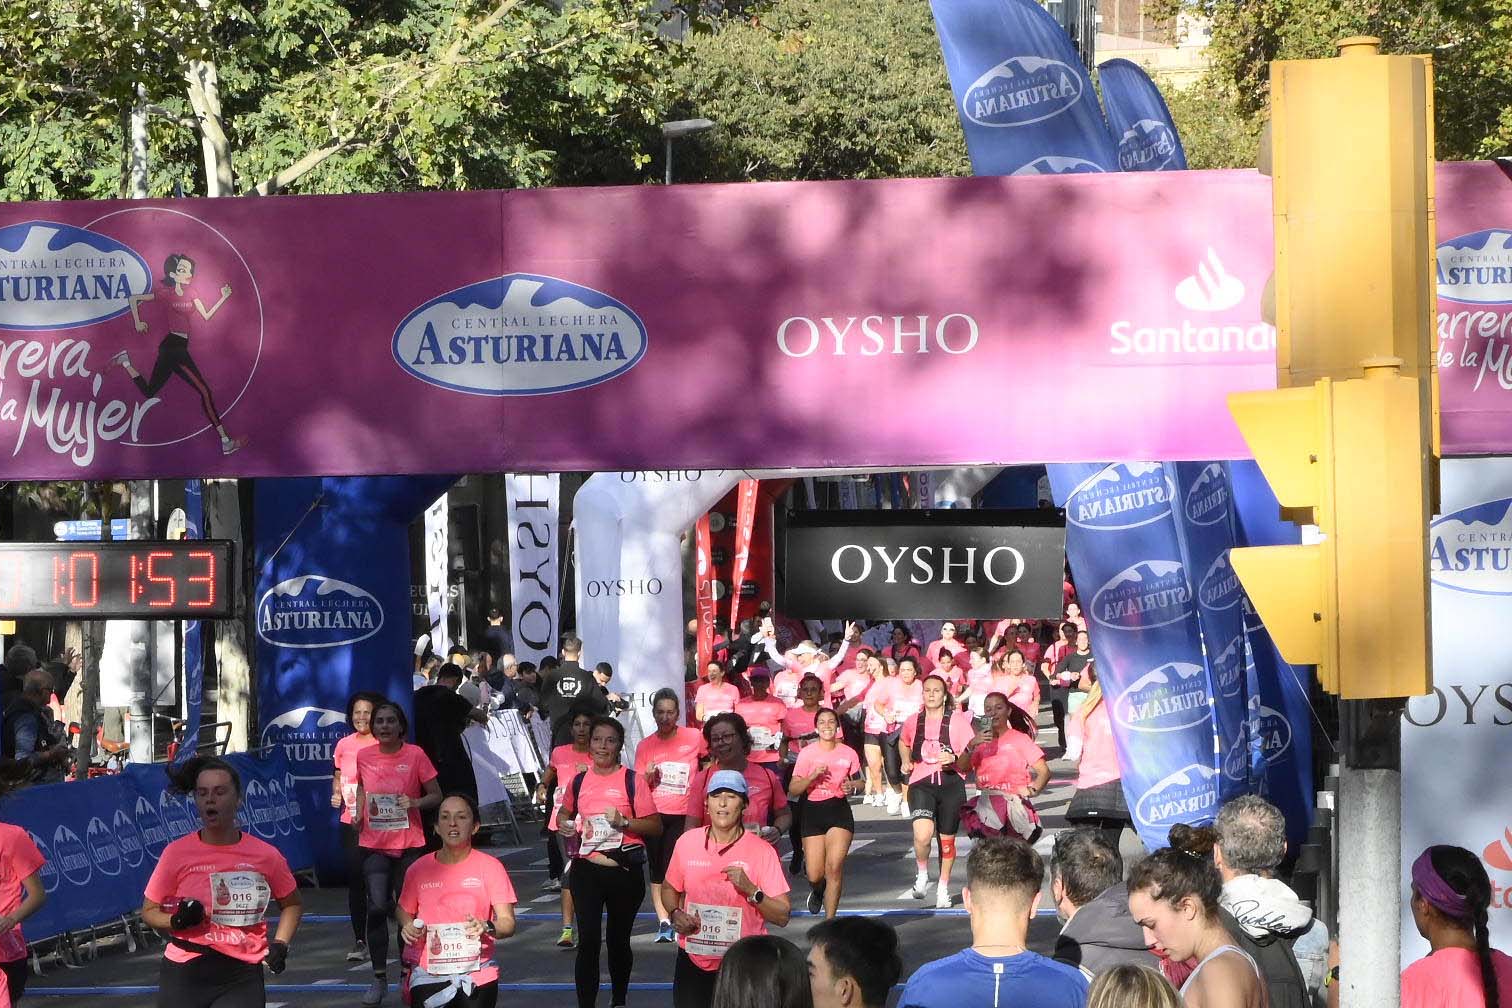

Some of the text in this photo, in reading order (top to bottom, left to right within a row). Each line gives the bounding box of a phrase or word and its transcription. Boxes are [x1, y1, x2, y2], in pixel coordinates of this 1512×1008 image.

[54, 257, 127, 270] LECHERA
[451, 314, 619, 330] CENTRAL LECHERA
[776, 313, 979, 359] OYSHO
[412, 320, 627, 366] ASTURIANA
[1110, 320, 1277, 355] Santand
[1460, 340, 1478, 368] la
[12, 373, 161, 467] Mujer
[831, 544, 1025, 587] OYSHO
[587, 577, 663, 598] OYSHO
[261, 604, 374, 632] ASTURIANA
[562, 681, 576, 691] BP
[232, 893, 252, 901] 016
[702, 925, 721, 934] 016
